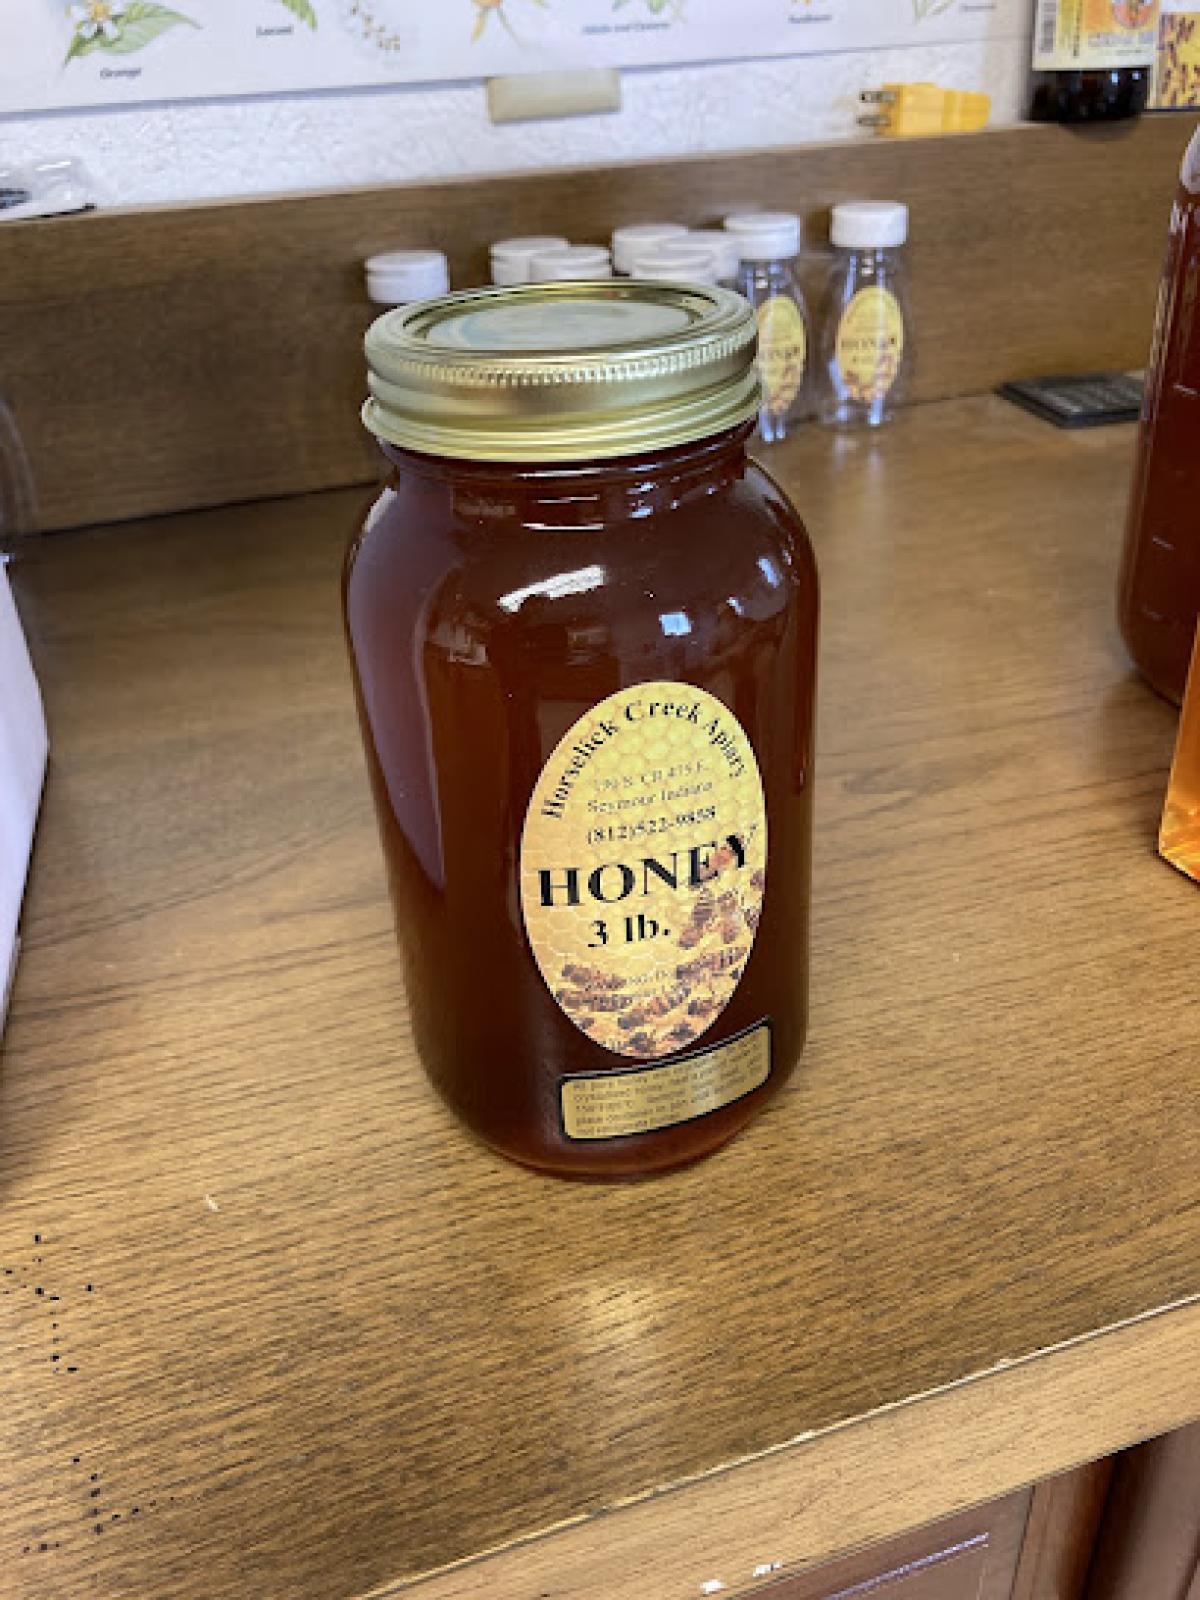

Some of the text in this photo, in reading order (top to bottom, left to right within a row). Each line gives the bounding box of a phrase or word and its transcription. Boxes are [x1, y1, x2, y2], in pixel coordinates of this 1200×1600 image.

[624, 700, 701, 724] Creek
[703, 717, 747, 779] Apiary
[536, 823, 758, 906] HONEY
[587, 914, 671, 948] 3 lb.
